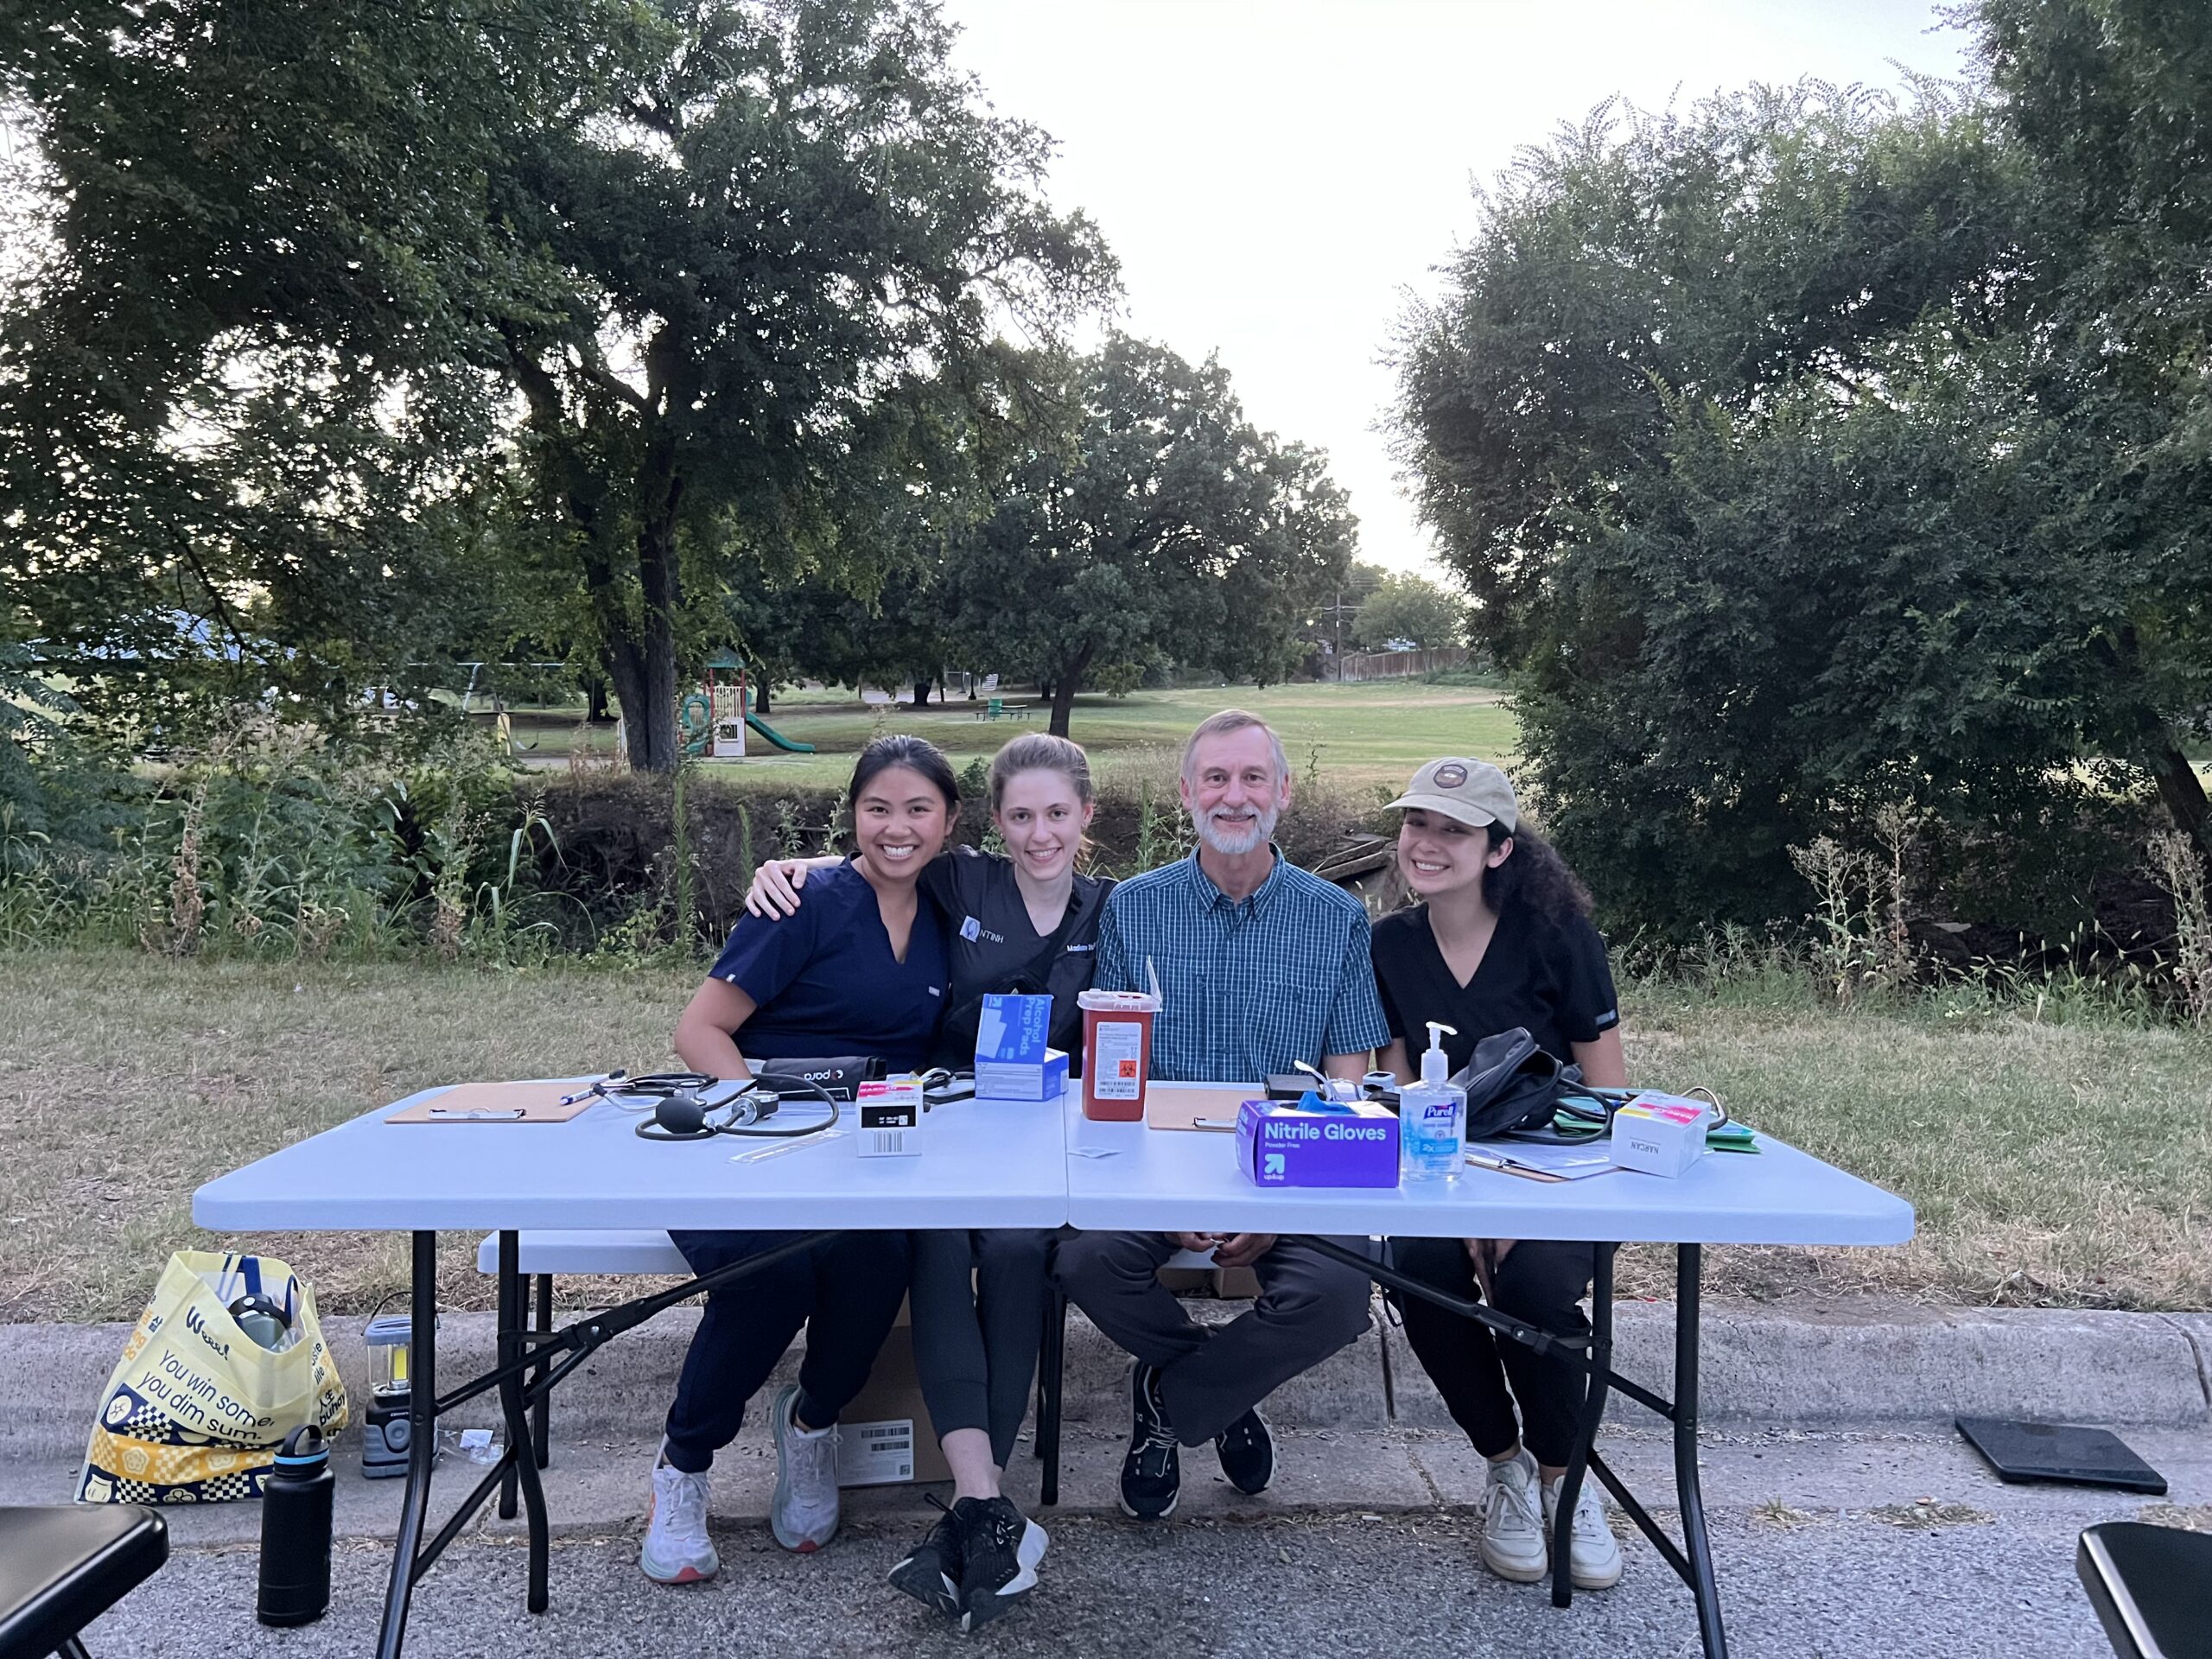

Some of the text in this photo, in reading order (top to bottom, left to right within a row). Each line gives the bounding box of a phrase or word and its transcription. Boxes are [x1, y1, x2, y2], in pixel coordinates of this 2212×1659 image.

[1020, 997, 1036, 1056] Prep Pads
[1032, 997, 1046, 1043] Alcohol
[1427, 1106, 1454, 1116] Purell
[1265, 1122, 1320, 1140] Nitrile
[1324, 1123, 1386, 1141] Gloves
[1630, 1141, 1660, 1155] NARCAN
[186, 1306, 230, 1361] Weee!
[159, 1349, 189, 1381] You
[187, 1373, 217, 1402] win
[314, 1366, 325, 1386] life
[137, 1371, 263, 1440] you dim sum.
[319, 1389, 334, 1414] 人生
